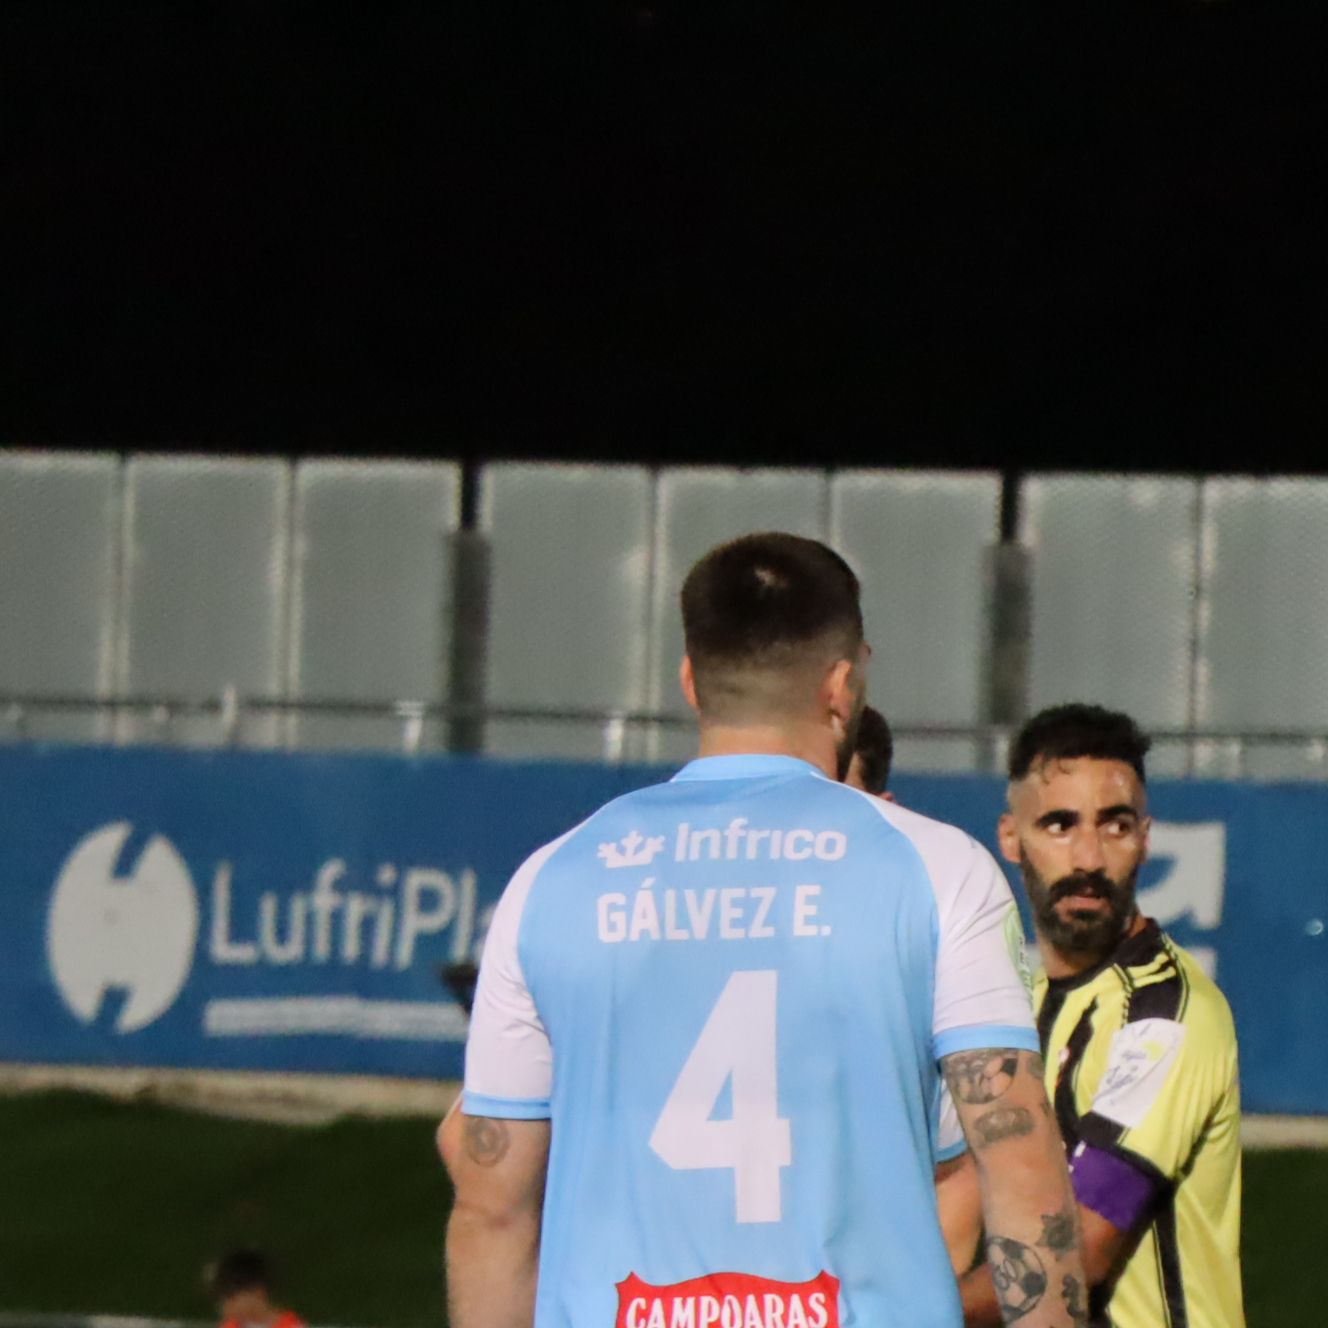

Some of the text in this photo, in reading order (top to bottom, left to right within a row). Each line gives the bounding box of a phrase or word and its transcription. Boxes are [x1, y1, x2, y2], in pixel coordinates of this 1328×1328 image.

[675, 818, 847, 863] Infrico
[597, 878, 831, 943] GÁLVEZ E.
[649, 969, 792, 1223] 4
